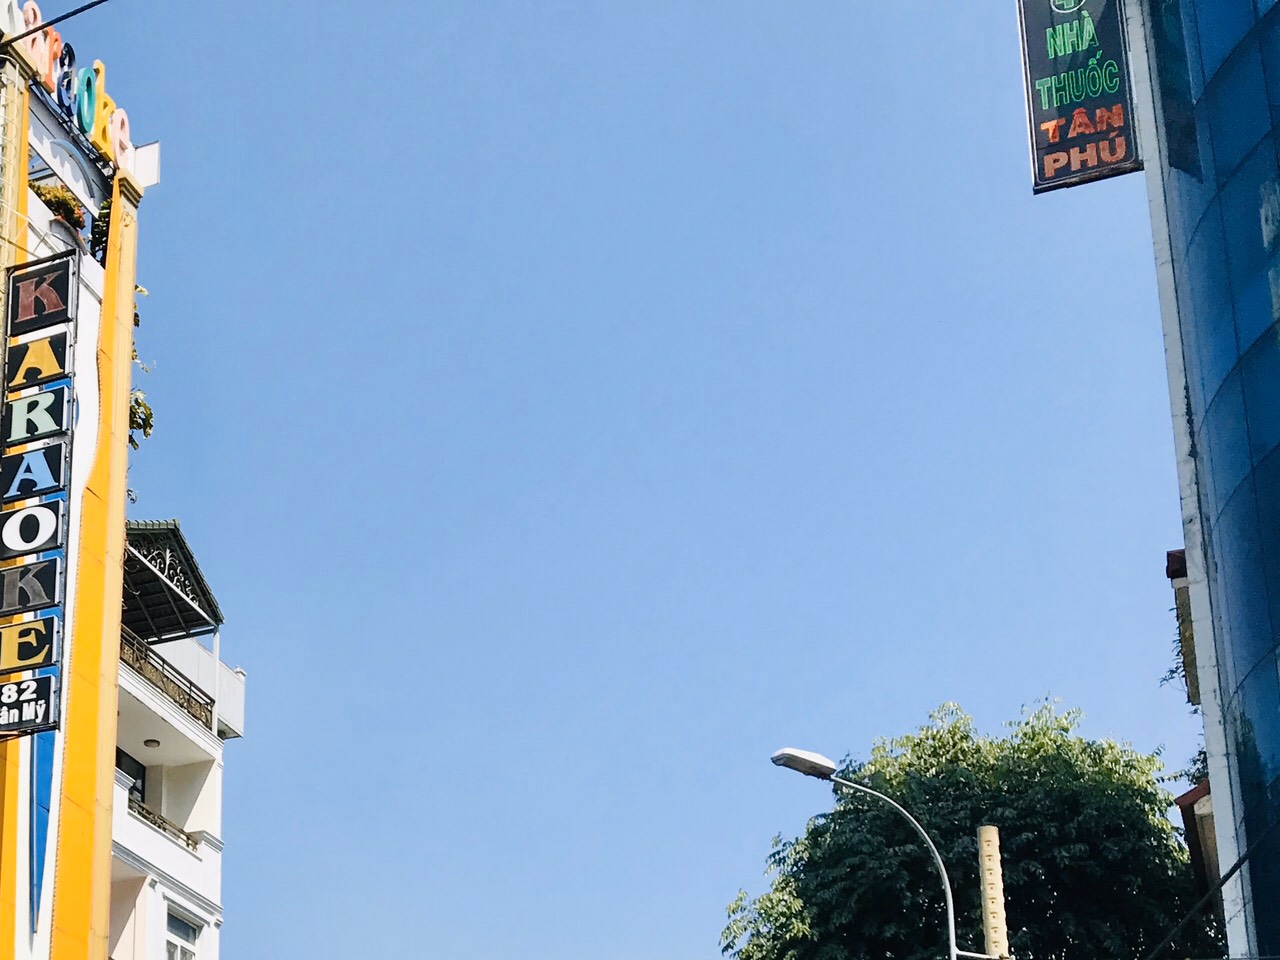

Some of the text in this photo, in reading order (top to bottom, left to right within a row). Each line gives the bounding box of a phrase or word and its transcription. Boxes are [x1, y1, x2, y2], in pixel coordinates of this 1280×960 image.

[1046, 10, 1099, 59] NHÀ
[1035, 50, 1120, 111] THUỐC
[1040, 104, 1125, 143] TÂN
[1043, 130, 1127, 178] PHÚ
[0, 680, 38, 704] 82
[21, 699, 47, 724] Mỹ
